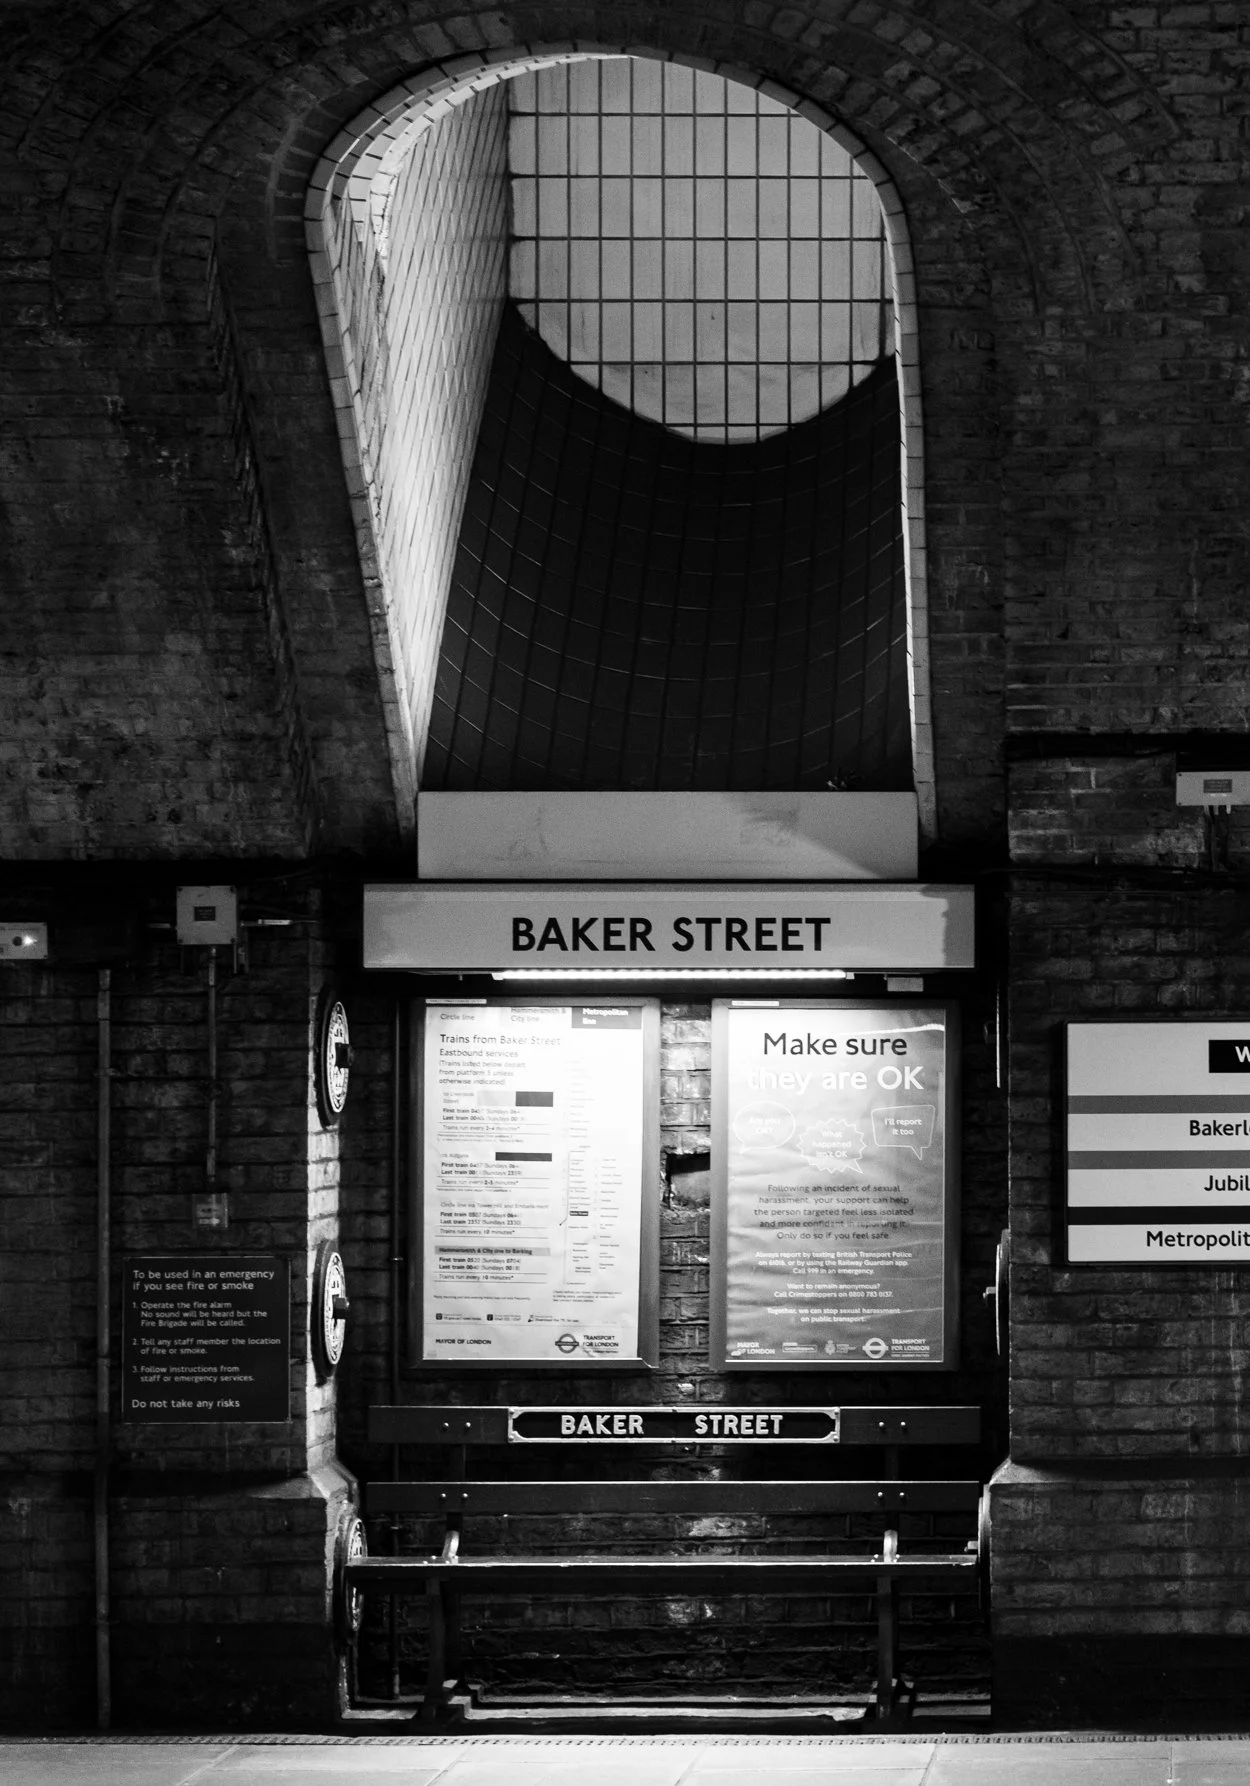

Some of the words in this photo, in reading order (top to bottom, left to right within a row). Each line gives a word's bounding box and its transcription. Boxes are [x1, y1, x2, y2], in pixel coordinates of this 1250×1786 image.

[511, 917, 656, 952] BAKER
[672, 917, 831, 952] STREET
[440, 1034, 470, 1043] Trains
[473, 1034, 497, 1043] from
[500, 1035, 527, 1045] Baker
[531, 1036, 561, 1046] Street
[764, 1033, 837, 1055] Make
[846, 1037, 907, 1055] sure
[440, 1049, 483, 1057] Eastbound
[747, 1066, 812, 1095] they
[823, 1070, 868, 1090] are
[876, 1066, 925, 1090] OK
[896, 1119, 922, 1129] report
[893, 1128, 898, 1136] it
[900, 1128, 914, 1136] too
[768, 1184, 810, 1193] Following
[825, 1184, 859, 1192] incident
[862, 1184, 871, 1192] of
[873, 1184, 900, 1192] sexual
[890, 1196, 909, 1205] help
[754, 1208, 768, 1216] the
[771, 1210, 800, 1218] person
[803, 1209, 839, 1218] targeted
[842, 1208, 858, 1216] feel
[861, 1208, 877, 1216] less
[880, 1208, 914, 1216] isolated
[776, 1232, 797, 1240] Only
[133, 1270, 145, 1279] To
[149, 1270, 161, 1279] be
[165, 1270, 189, 1279] used
[192, 1270, 201, 1279] in
[220, 1271, 275, 1280] emergency
[133, 1282, 140, 1290] if
[144, 1283, 162, 1292] you
[187, 1282, 205, 1290] fire
[222, 1282, 254, 1290] smoke
[789, 1291, 837, 1299] Crimestoppers
[141, 1302, 175, 1310] Operate
[159, 1320, 187, 1328] Brigade
[158, 1339, 171, 1347] any
[132, 1400, 146, 1408] Do
[150, 1400, 168, 1408] not
[172, 1400, 193, 1408] take
[196, 1401, 213, 1409] any
[217, 1400, 240, 1408] risks
[561, 1414, 644, 1436] BAKER
[694, 1414, 784, 1436] STREET
